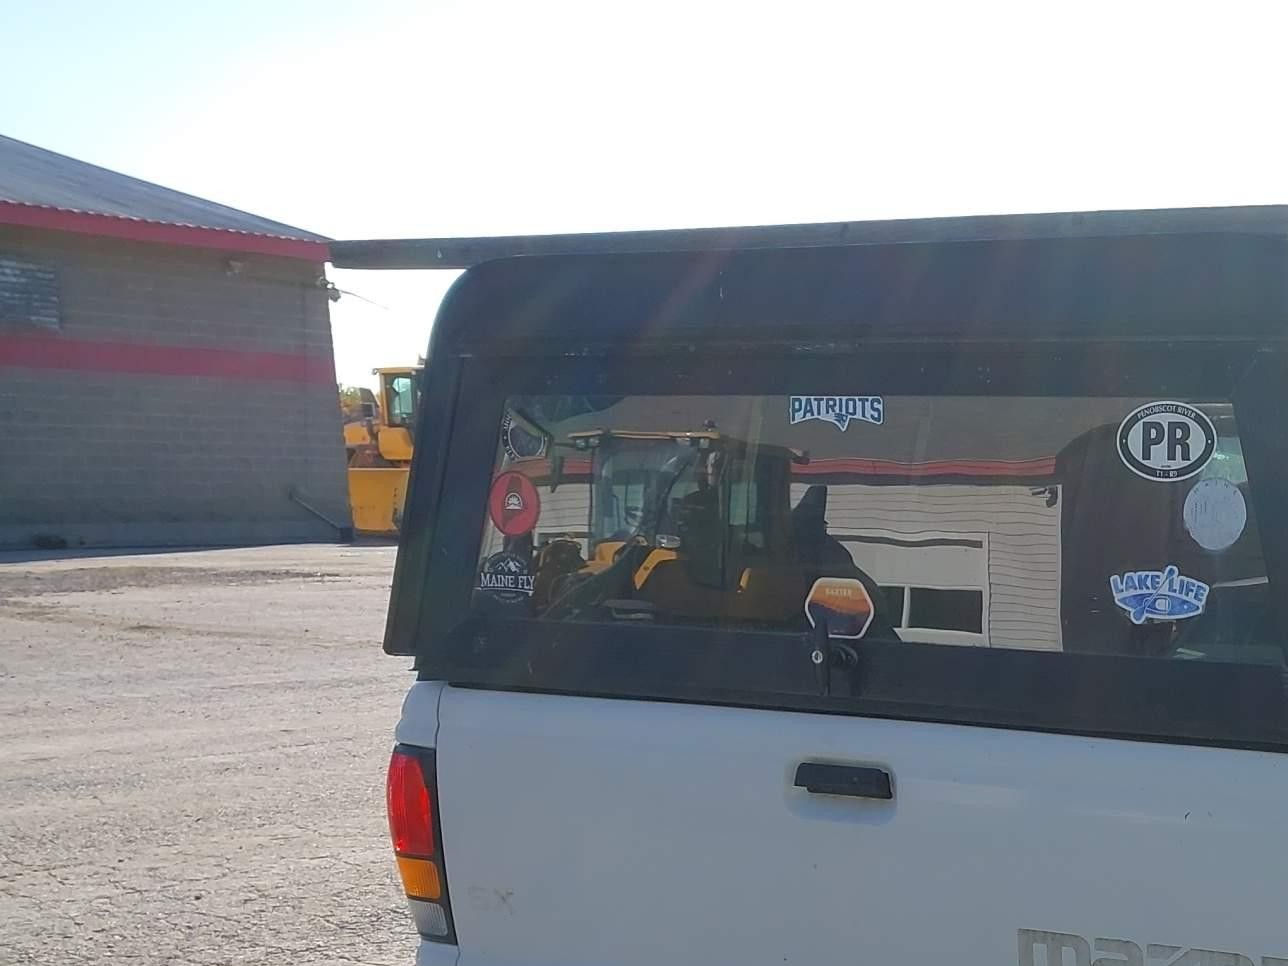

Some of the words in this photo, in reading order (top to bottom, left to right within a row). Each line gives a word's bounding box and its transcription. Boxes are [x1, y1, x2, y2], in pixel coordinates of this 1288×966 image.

[791, 397, 882, 422] PATRIOTS
[1137, 404, 1176, 419] PENOBSCOT
[1177, 405, 1197, 419] RIVER
[1142, 421, 1192, 461] PR
[480, 572, 515, 588] MAINE
[518, 575, 536, 590] FLY
[1112, 573, 1161, 594] LAKE
[1168, 578, 1207, 602] LIFE
